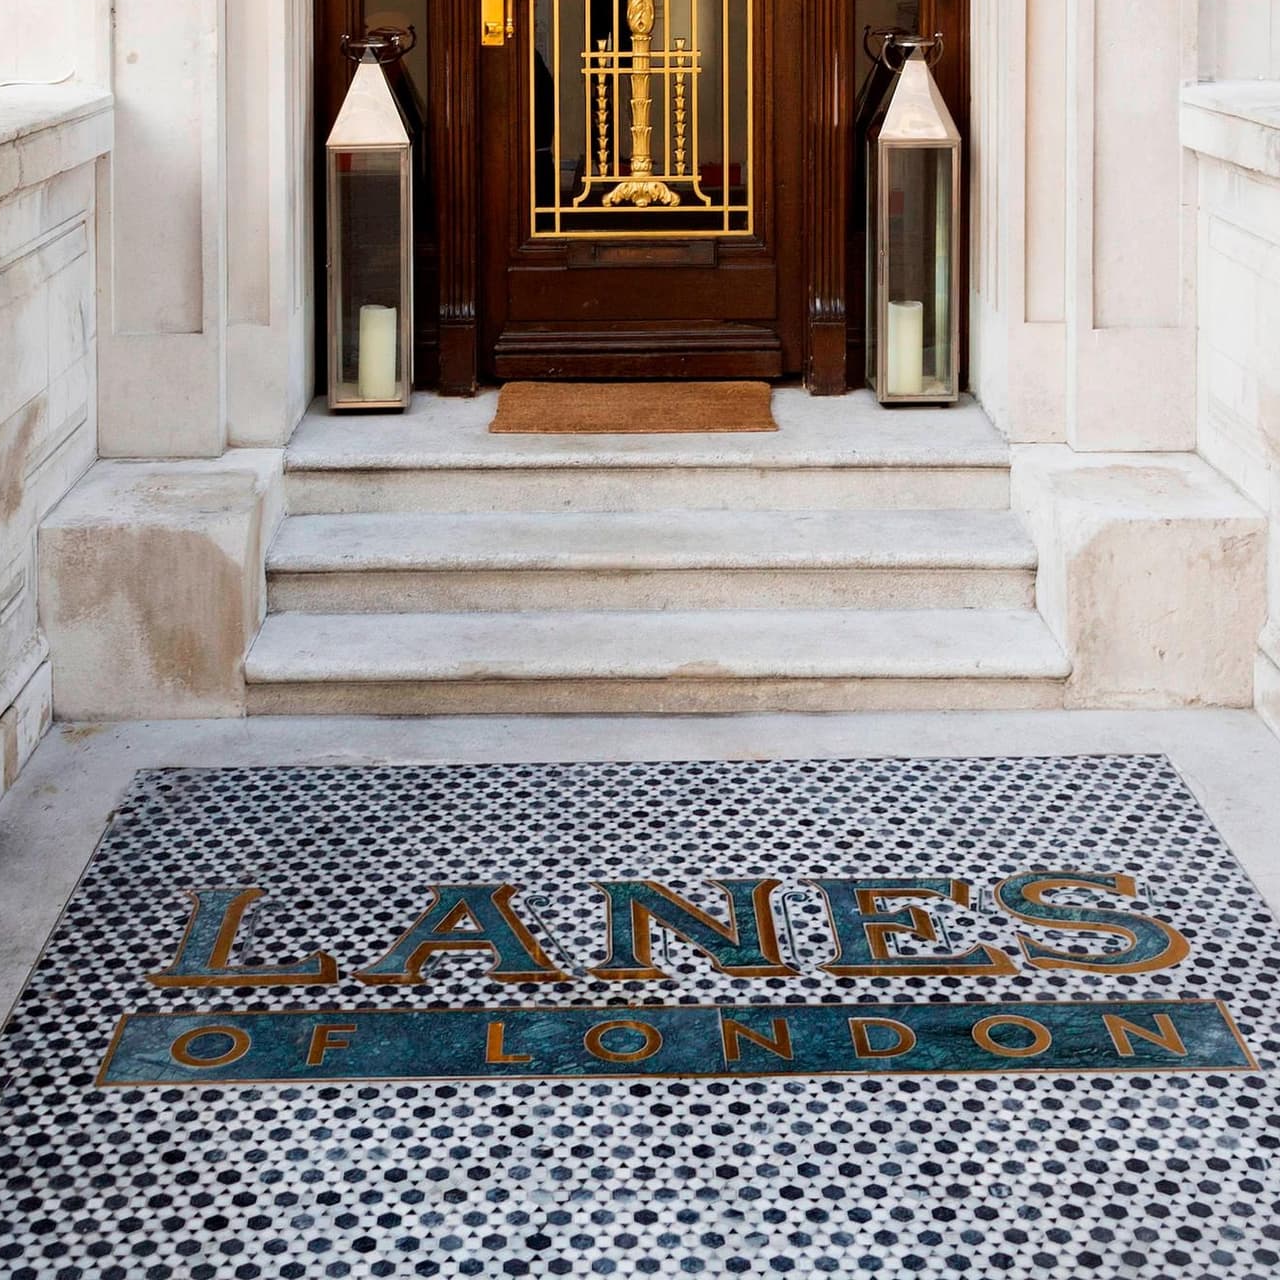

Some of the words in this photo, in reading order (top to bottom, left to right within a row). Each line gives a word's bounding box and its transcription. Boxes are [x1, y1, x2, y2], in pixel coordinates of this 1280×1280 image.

[146, 870, 1191, 987] LANES
[169, 1023, 358, 1068] OF
[484, 1013, 1189, 1065] LONDON
